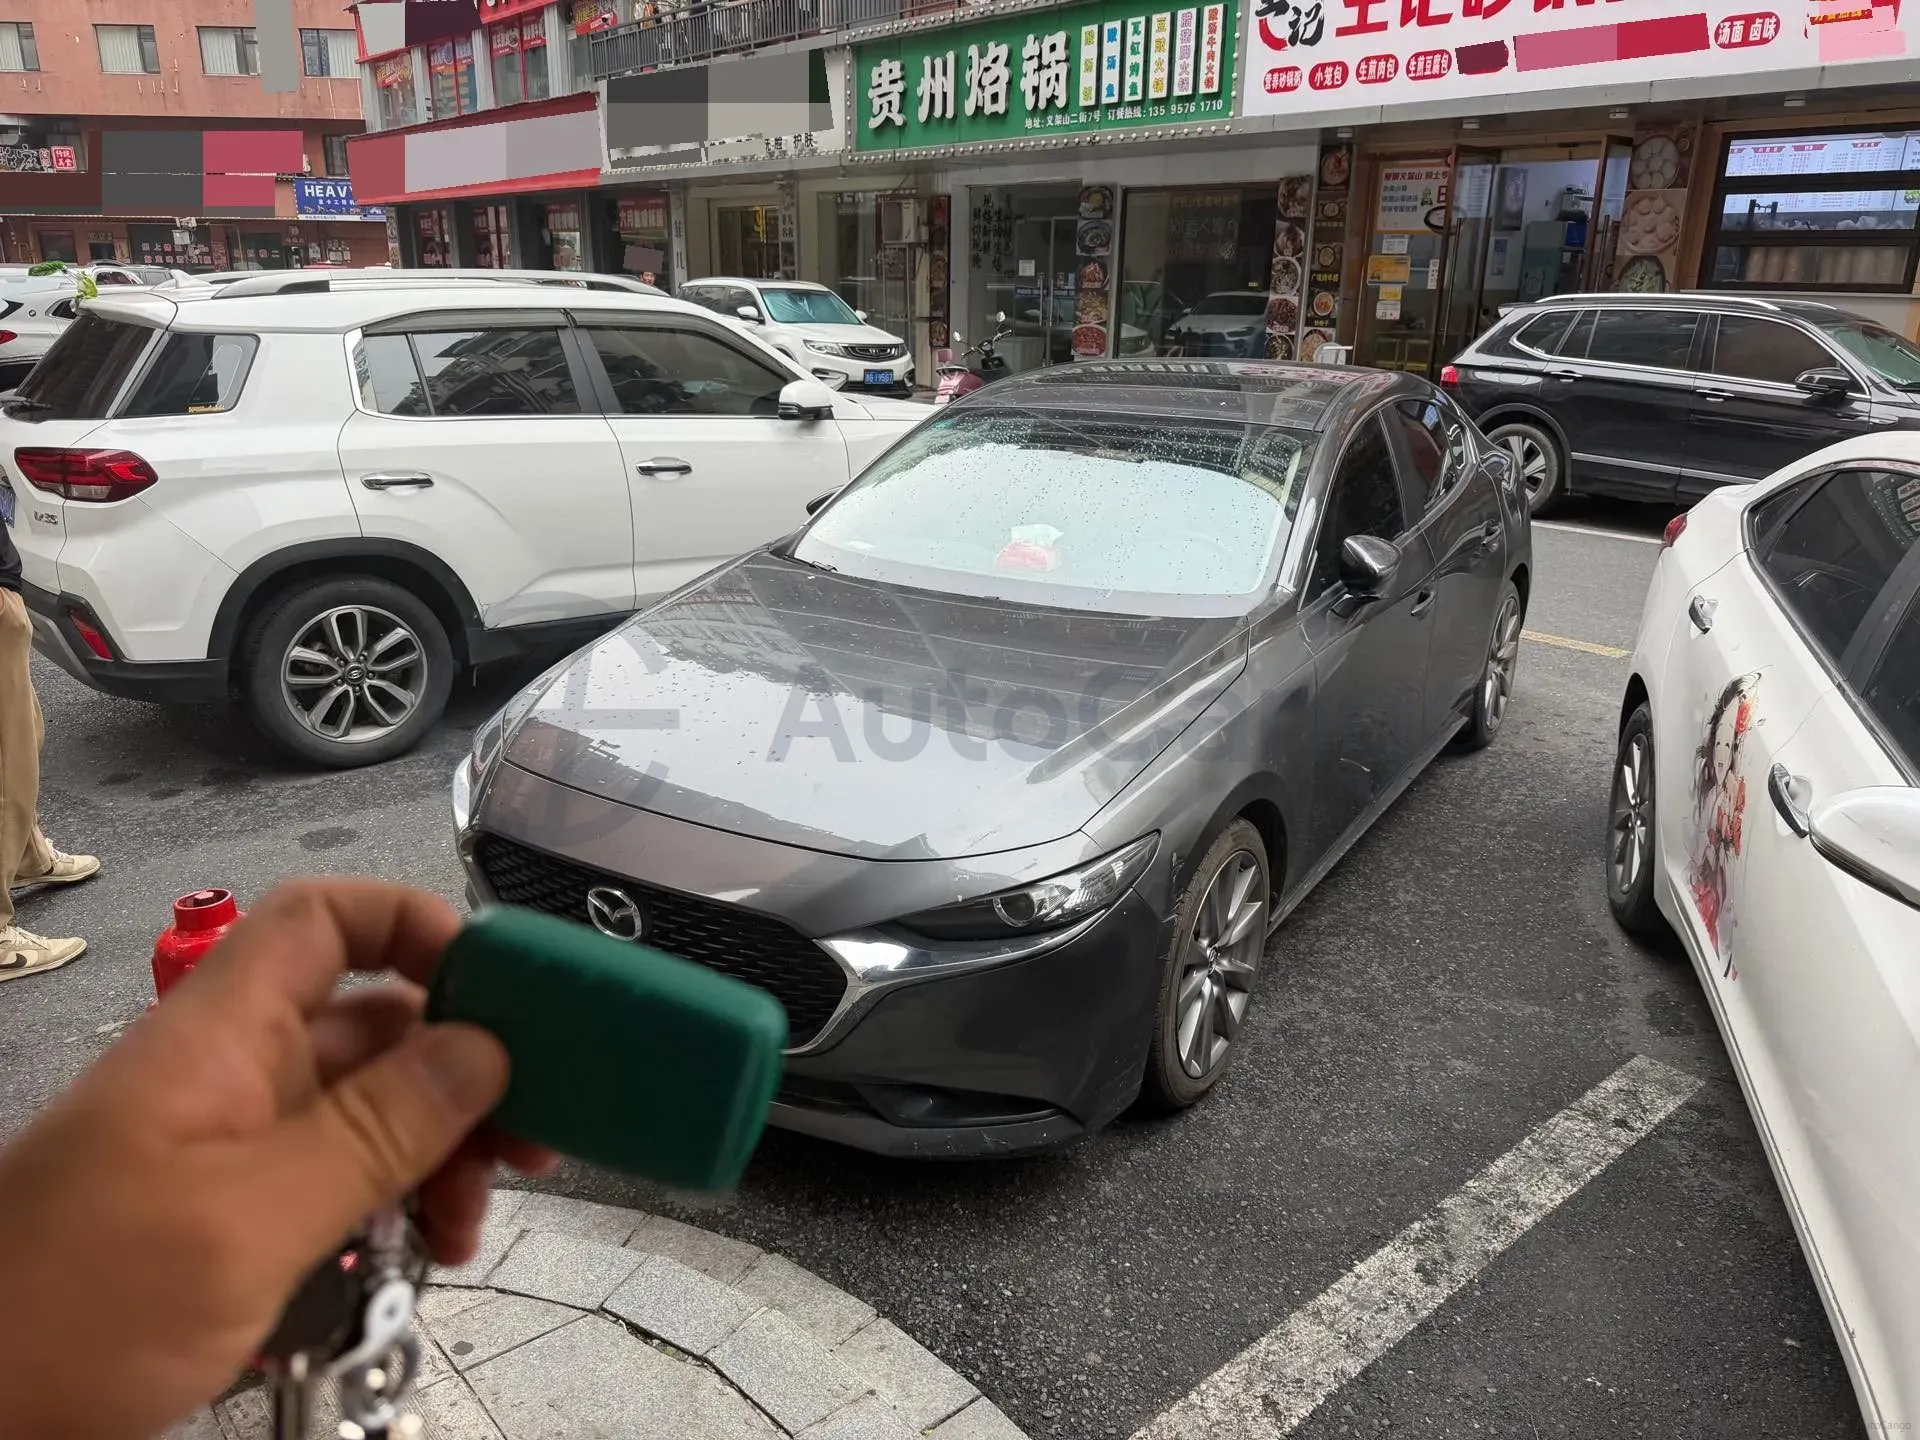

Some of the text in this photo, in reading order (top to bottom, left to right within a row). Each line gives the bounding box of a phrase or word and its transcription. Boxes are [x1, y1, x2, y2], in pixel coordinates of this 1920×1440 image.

[1717, 15, 1776, 45] 汤面 卤味
[1314, 64, 1343, 87] 小笼包
[1359, 57, 1396, 81] 生煎肉包
[1408, 53, 1449, 77] 生煎豆腐包
[867, 30, 1069, 129] 贵州烙锅
[1264, 70, 1302, 90] 营养砂锅粥
[1170, 102, 1197, 115] 9576
[1200, 99, 1224, 112] 1710
[304, 185, 352, 198] HEAV
